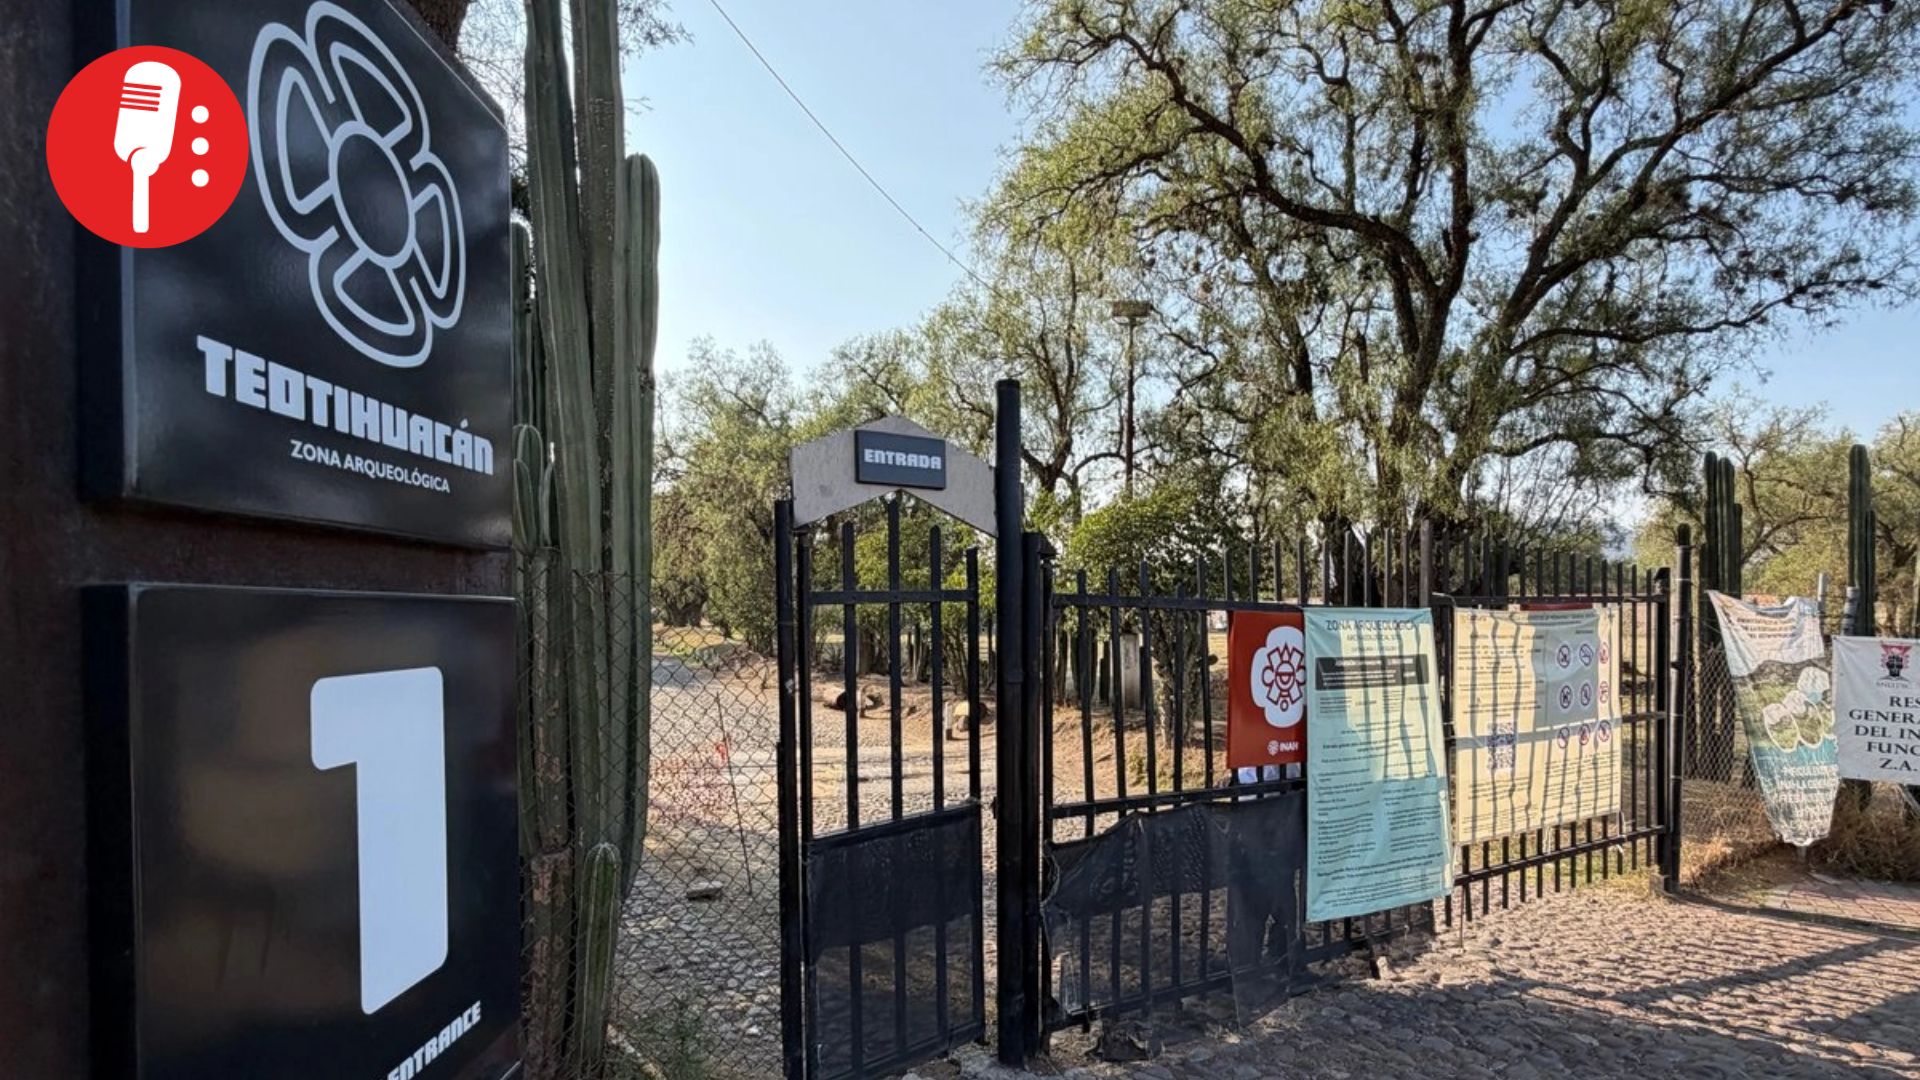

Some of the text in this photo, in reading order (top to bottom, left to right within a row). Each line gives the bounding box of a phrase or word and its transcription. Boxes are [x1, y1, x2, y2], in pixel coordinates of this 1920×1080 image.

[196, 335, 494, 476] TEOTIHUACÁN
[291, 440, 451, 494] ZONA ARQUEOLÓGICA
[863, 448, 942, 470] ENTRADA
[1325, 620, 1352, 632] ZONA
[1855, 725, 1892, 738] DEL
[1280, 742, 1299, 753] INAH
[310, 666, 448, 1015] 1
